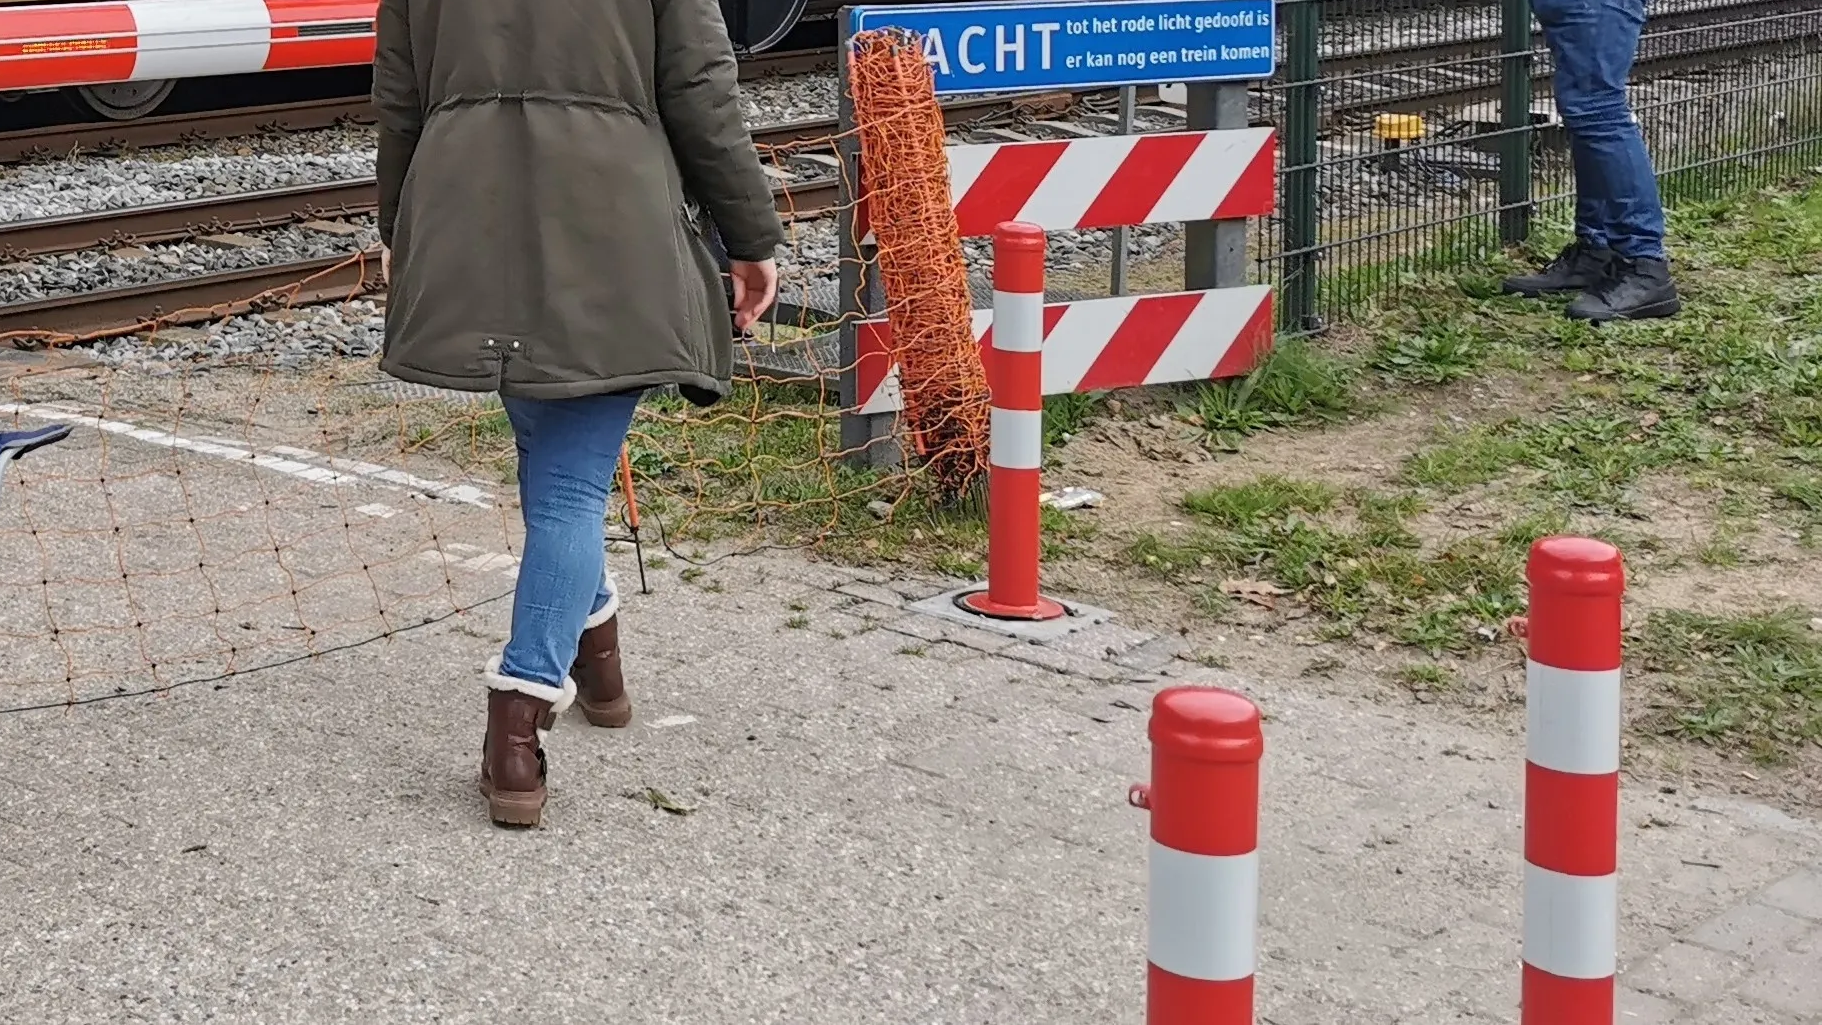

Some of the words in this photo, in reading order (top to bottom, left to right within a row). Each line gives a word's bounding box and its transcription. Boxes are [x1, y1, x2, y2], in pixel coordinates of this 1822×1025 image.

[1065, 19, 1090, 36] tot
[1092, 17, 1118, 35] het
[1121, 15, 1155, 33] rode
[1158, 13, 1192, 31] licht
[1194, 10, 1254, 34] gedoofd
[1256, 10, 1270, 27] is
[890, 22, 1061, 75] ACHT
[1065, 55, 1082, 69] er
[1085, 51, 1114, 68] kan
[1117, 51, 1146, 70] nog
[1149, 50, 1178, 65] een
[1181, 45, 1217, 63] trein
[1220, 44, 1270, 61] komen
